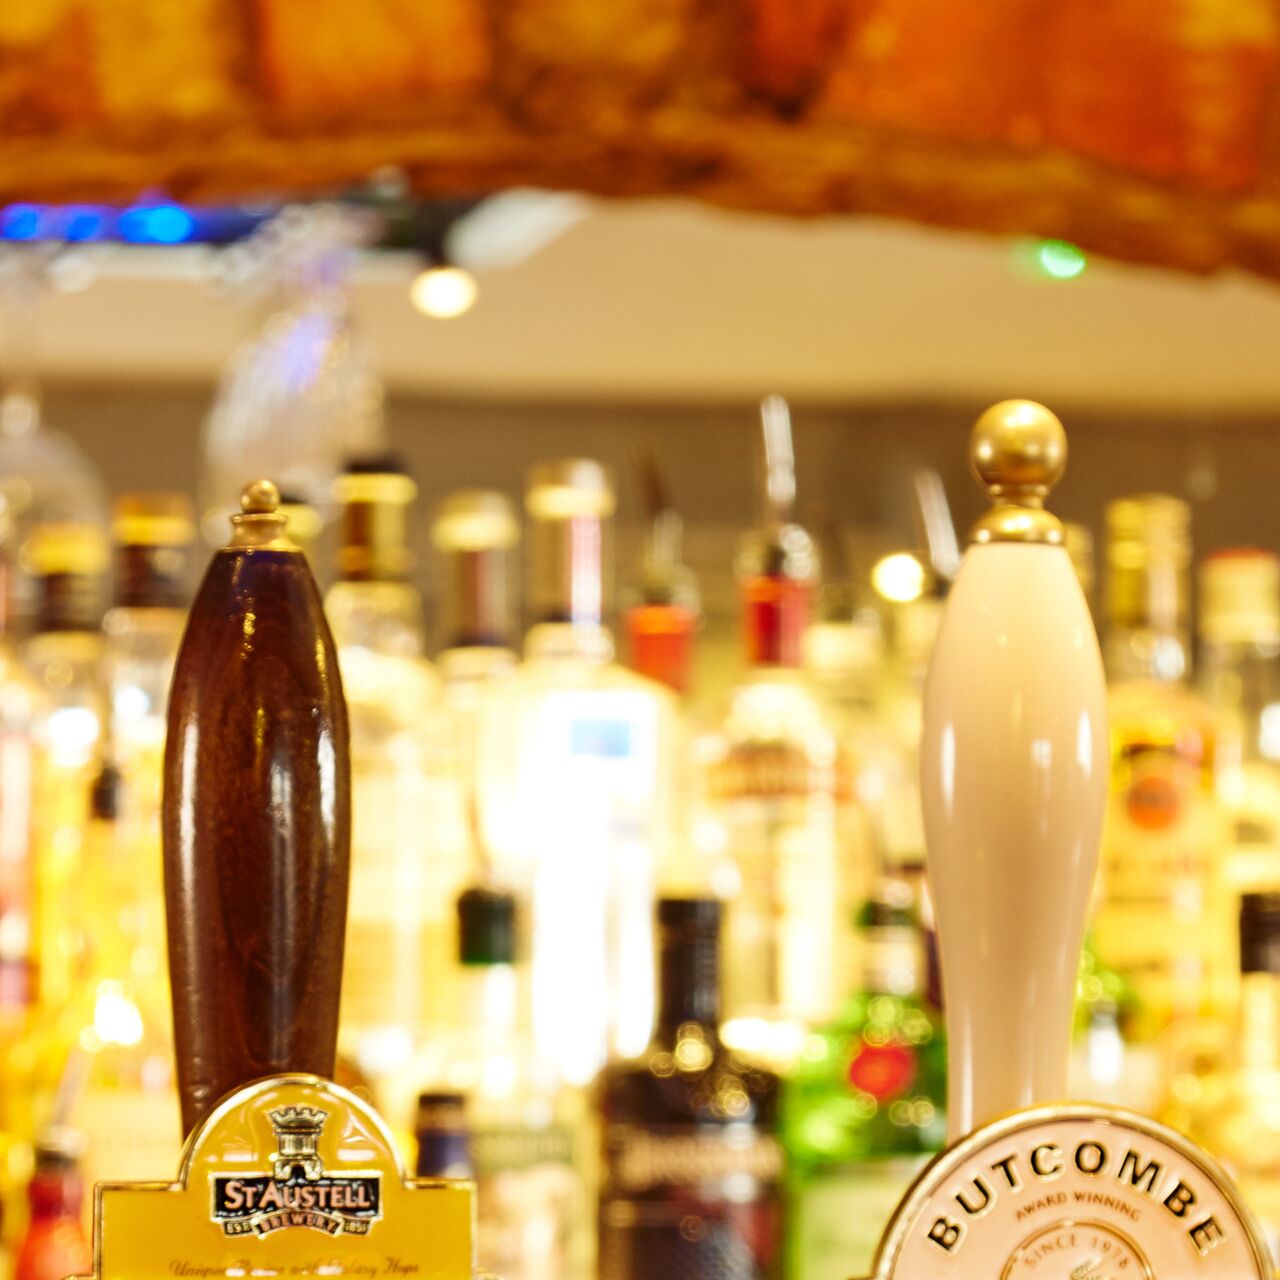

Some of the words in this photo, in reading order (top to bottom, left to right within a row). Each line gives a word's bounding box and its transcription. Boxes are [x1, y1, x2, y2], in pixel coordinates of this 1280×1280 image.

[259, 1181, 370, 1209] AUSTELL
[927, 1141, 1225, 1254] BUTCOMBE
[1016, 1193, 1068, 1221] AWARD
[1073, 1192, 1141, 1222] WINNING
[260, 1211, 337, 1233] BREWERY
[1024, 1233, 1077, 1268] SINCE
